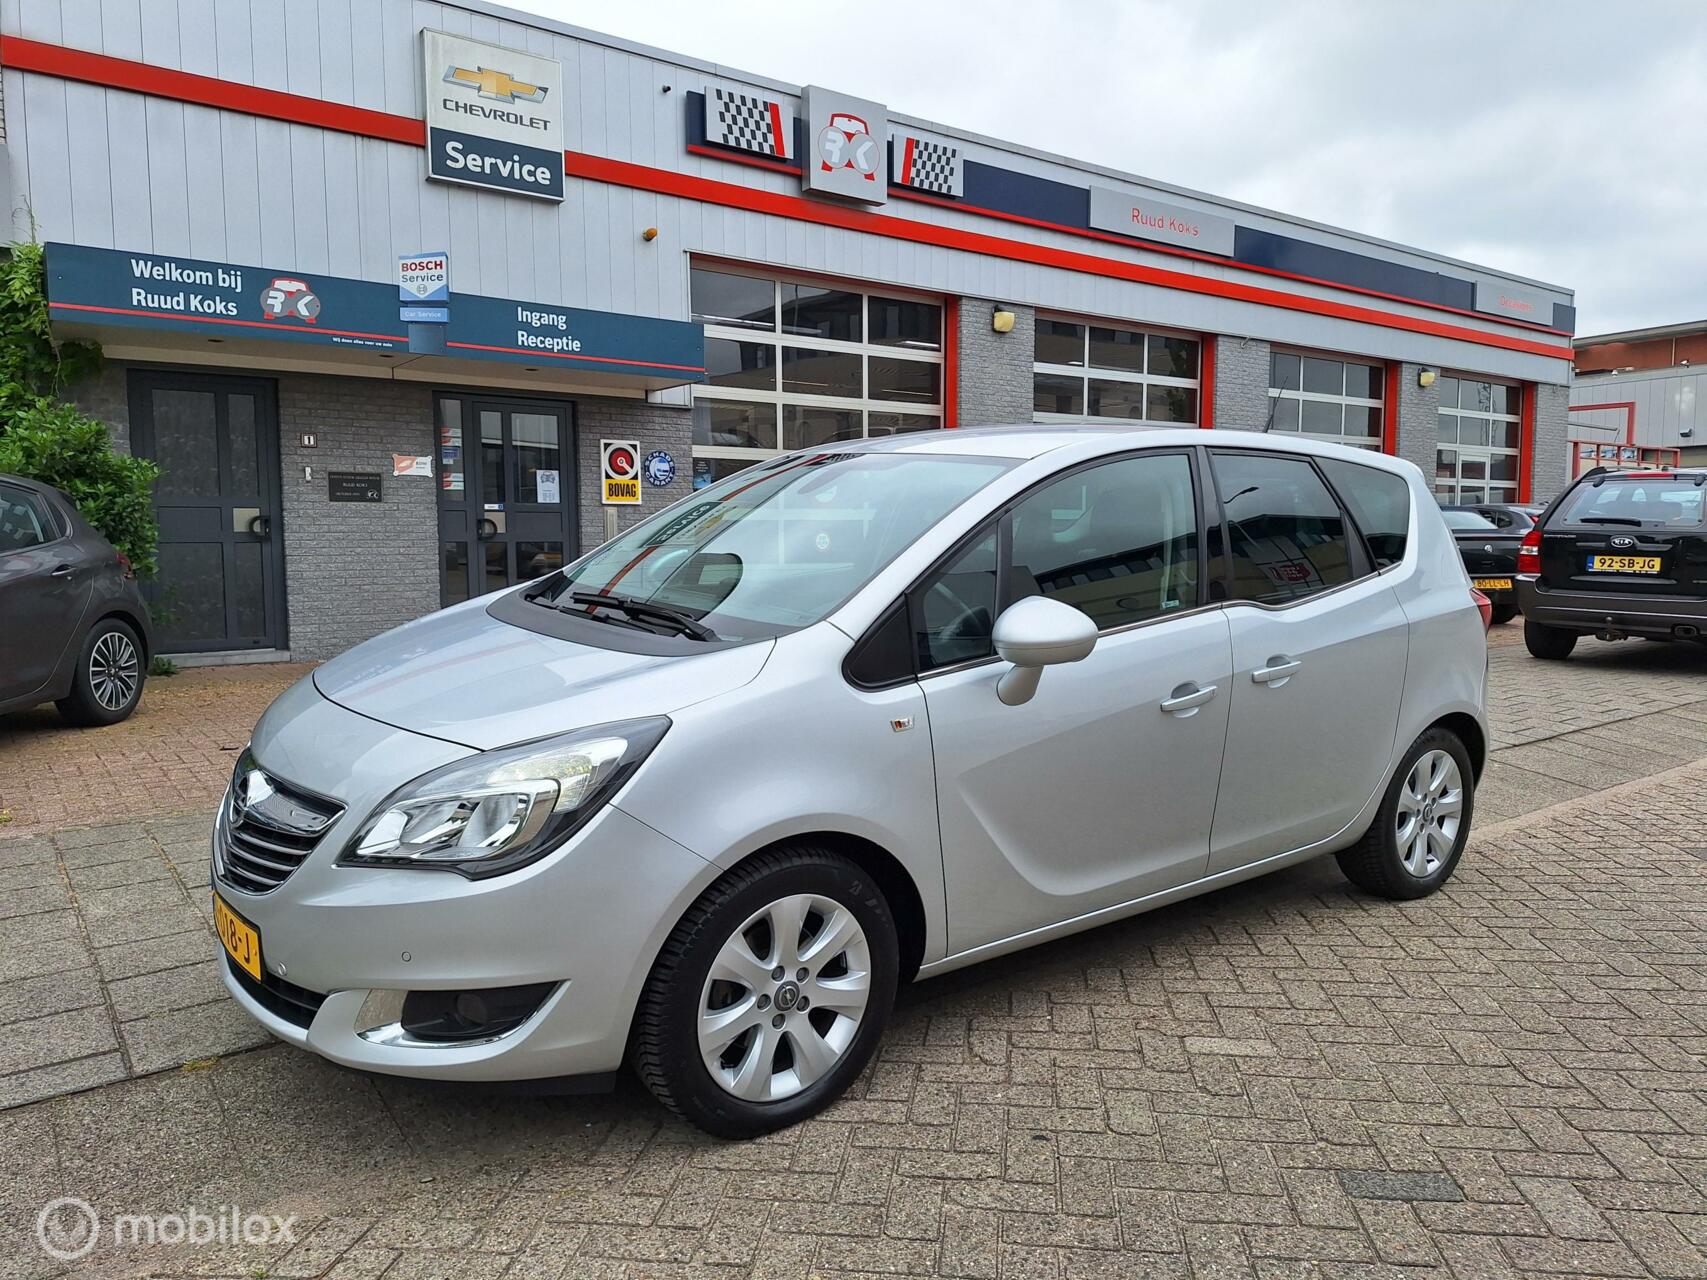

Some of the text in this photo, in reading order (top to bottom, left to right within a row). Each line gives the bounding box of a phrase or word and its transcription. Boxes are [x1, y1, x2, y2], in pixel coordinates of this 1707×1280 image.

[442, 98, 551, 131] CHEVROLET
[445, 140, 551, 185] Service
[1131, 207, 1200, 237] Ruud Koks
[130, 258, 242, 293] Welkom bij
[401, 260, 443, 272] BOSCH
[401, 272, 444, 283] Service
[131, 287, 238, 316] Ruud Koks
[517, 306, 567, 330] Ingang
[517, 330, 581, 353] Receptie
[645, 451, 675, 467] SCHADE
[645, 471, 675, 486] GARANT
[608, 482, 637, 497] BOVAG
[1613, 538, 1630, 546] KIA
[1599, 557, 1655, 569] 92-SB-JG
